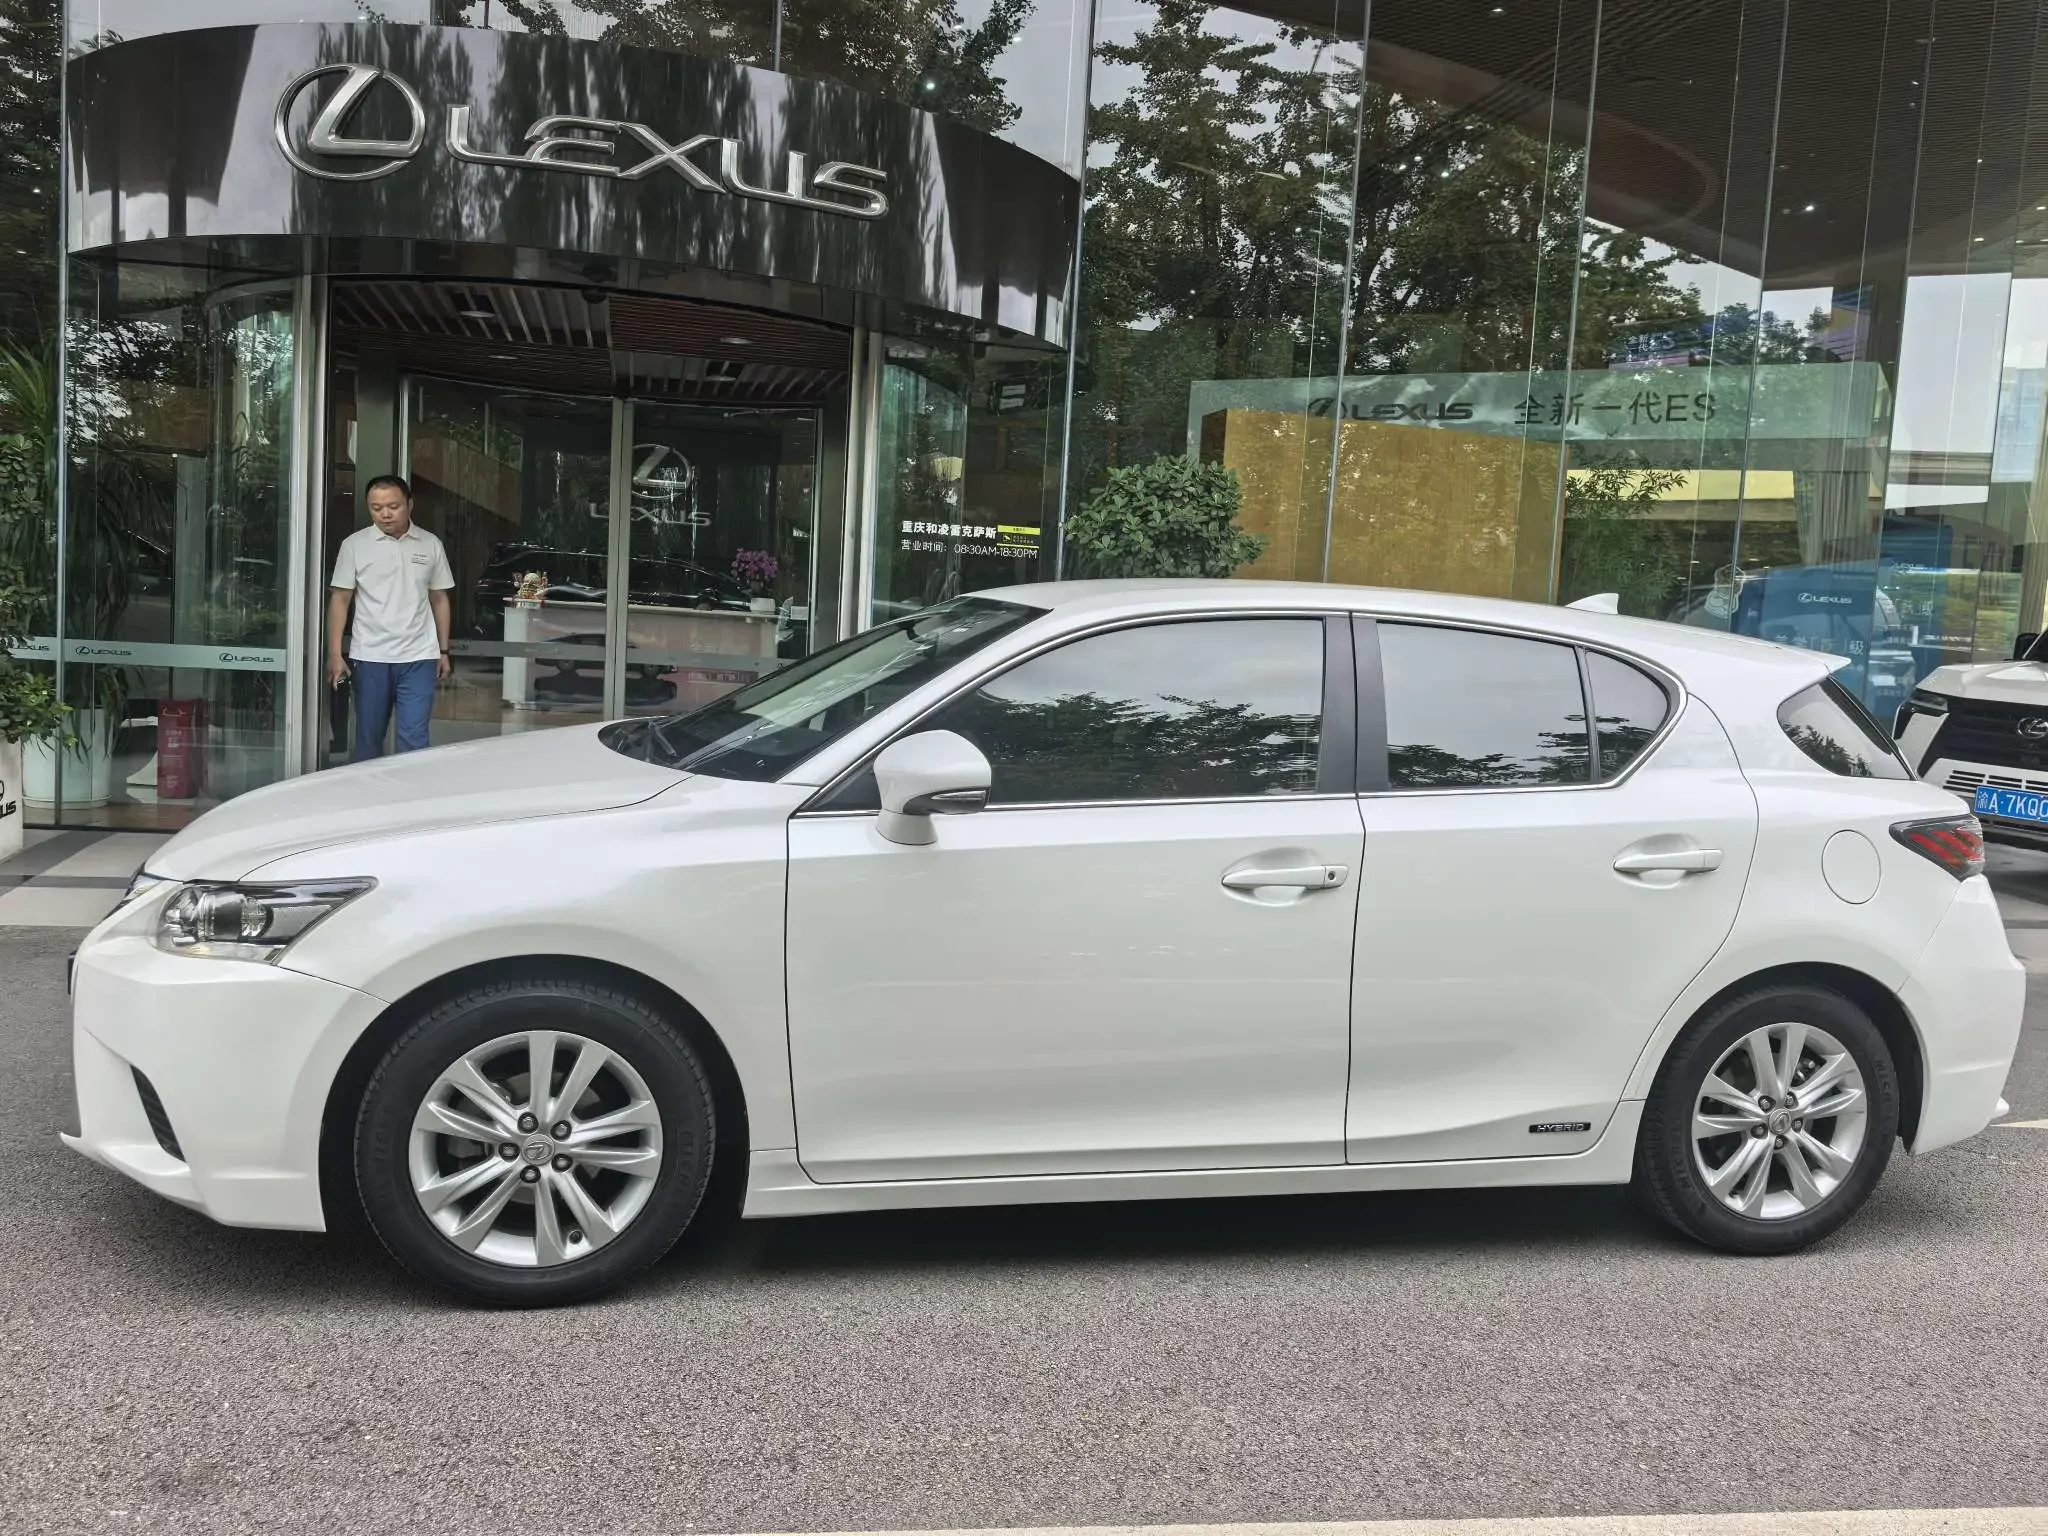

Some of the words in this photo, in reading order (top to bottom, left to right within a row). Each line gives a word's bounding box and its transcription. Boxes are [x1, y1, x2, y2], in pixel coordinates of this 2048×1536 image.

[445, 103, 889, 219] LEXUS
[1351, 402, 1475, 421] LEXUS
[1513, 391, 1717, 426] 全新一代ES
[589, 502, 712, 527] LXUS
[901, 520, 997, 539] 重庆和凌雷克萨斯
[1537, 1123, 1584, 1132] HYBRID
